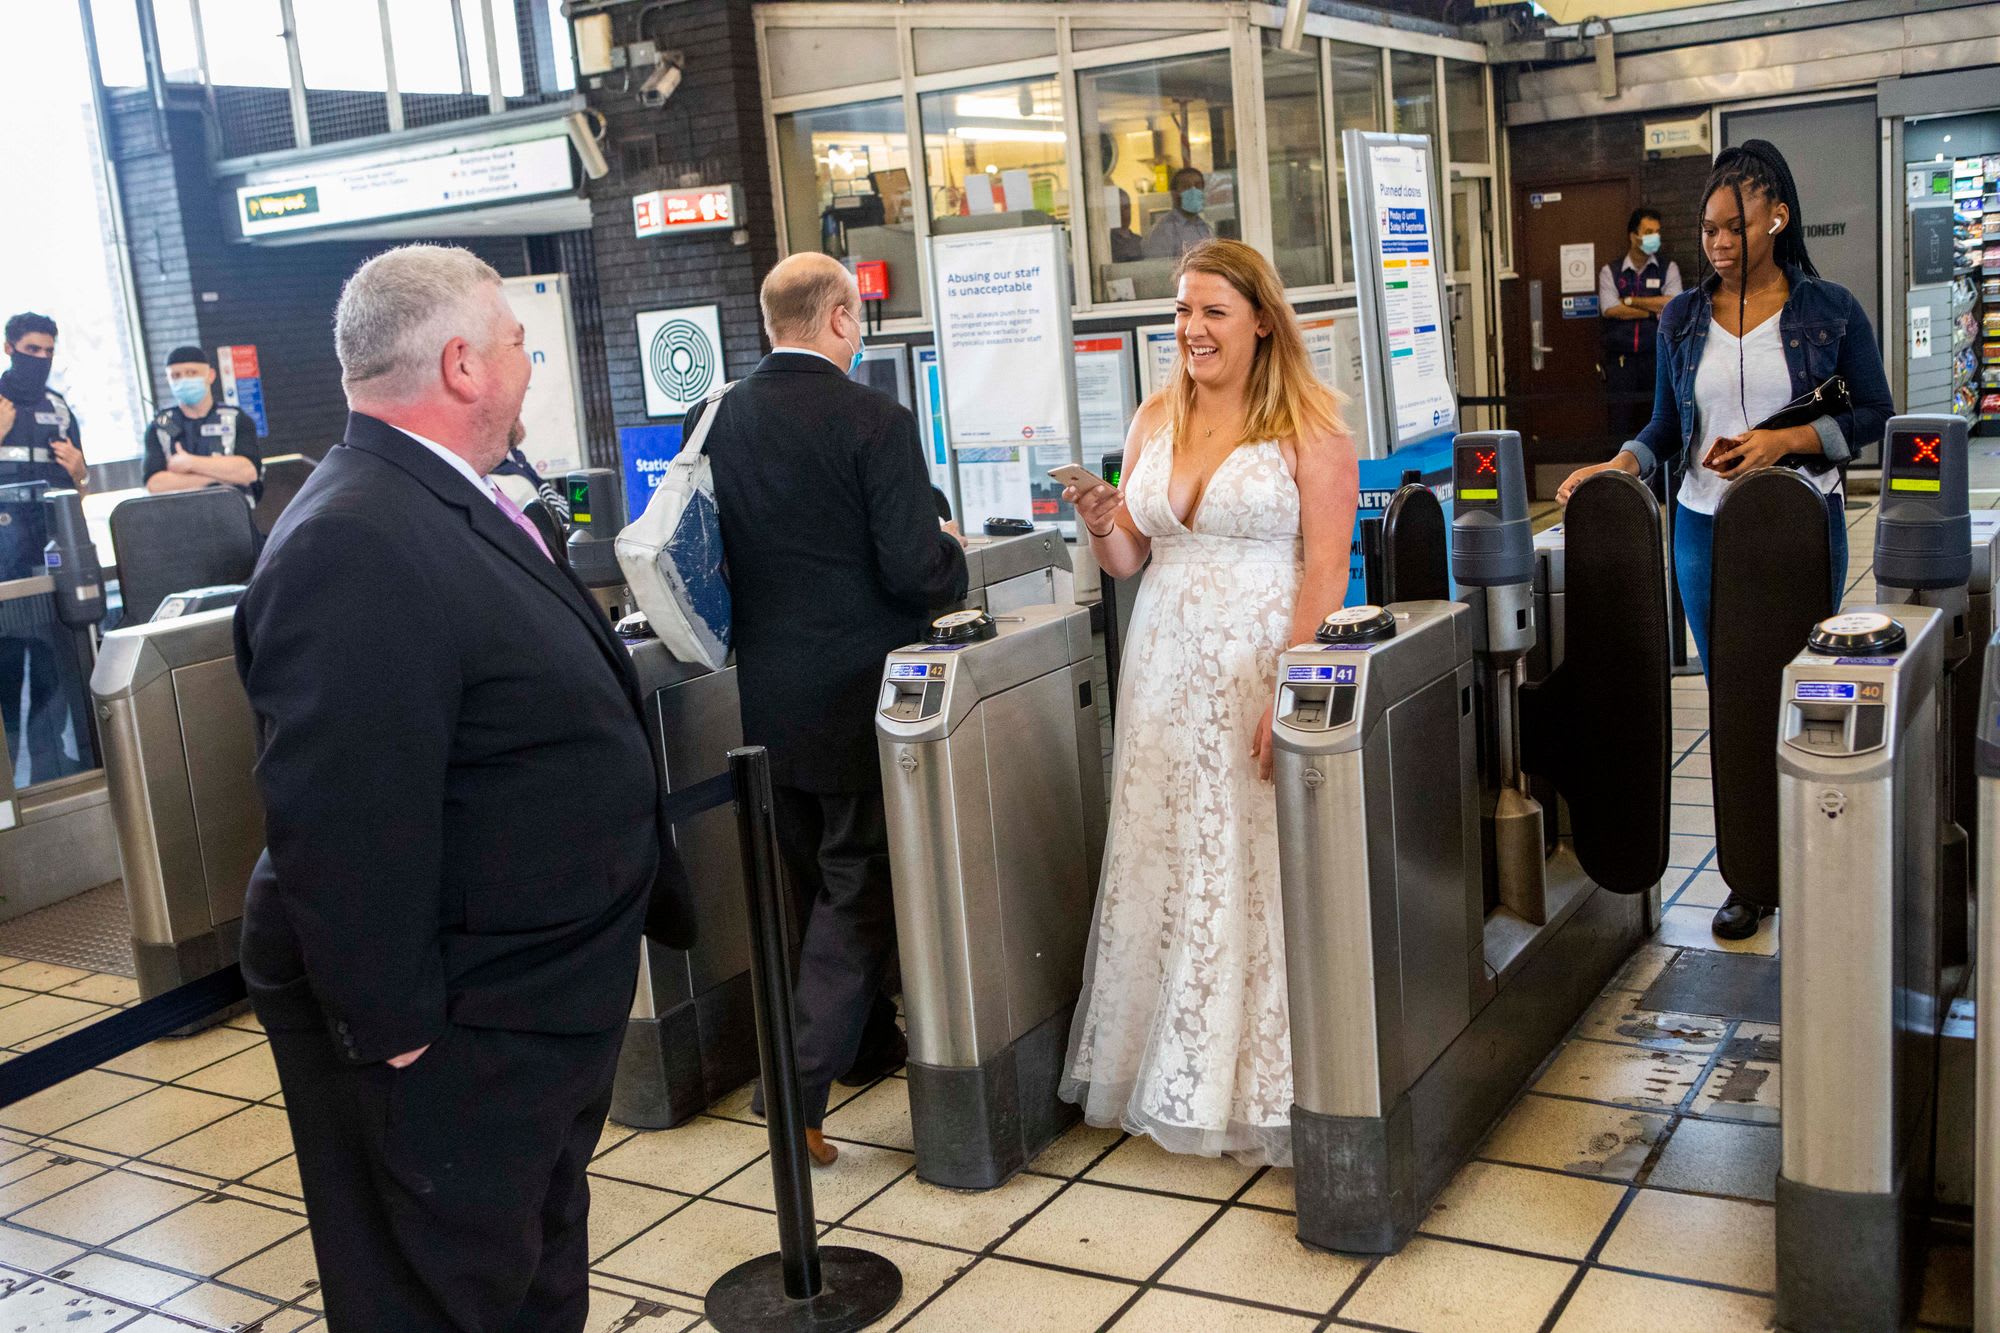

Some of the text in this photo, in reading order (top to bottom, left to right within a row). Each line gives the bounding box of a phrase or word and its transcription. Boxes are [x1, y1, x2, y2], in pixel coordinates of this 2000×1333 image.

[1802, 222, 1846, 238] TIONERY
[948, 266, 1040, 284] Abusing our staff
[948, 282, 1032, 297] is unacceptable
[976, 311, 999, 319] always
[984, 320, 1008, 328] penalty
[1009, 318, 1032, 326] against
[993, 328, 1019, 336] verbally
[636, 458, 671, 472] Statio
[648, 474, 664, 488] Ex
[1358, 492, 1392, 508] ETR
[930, 666, 943, 676] 42
[1336, 669, 1352, 680] 41
[1862, 686, 1880, 697] 40
